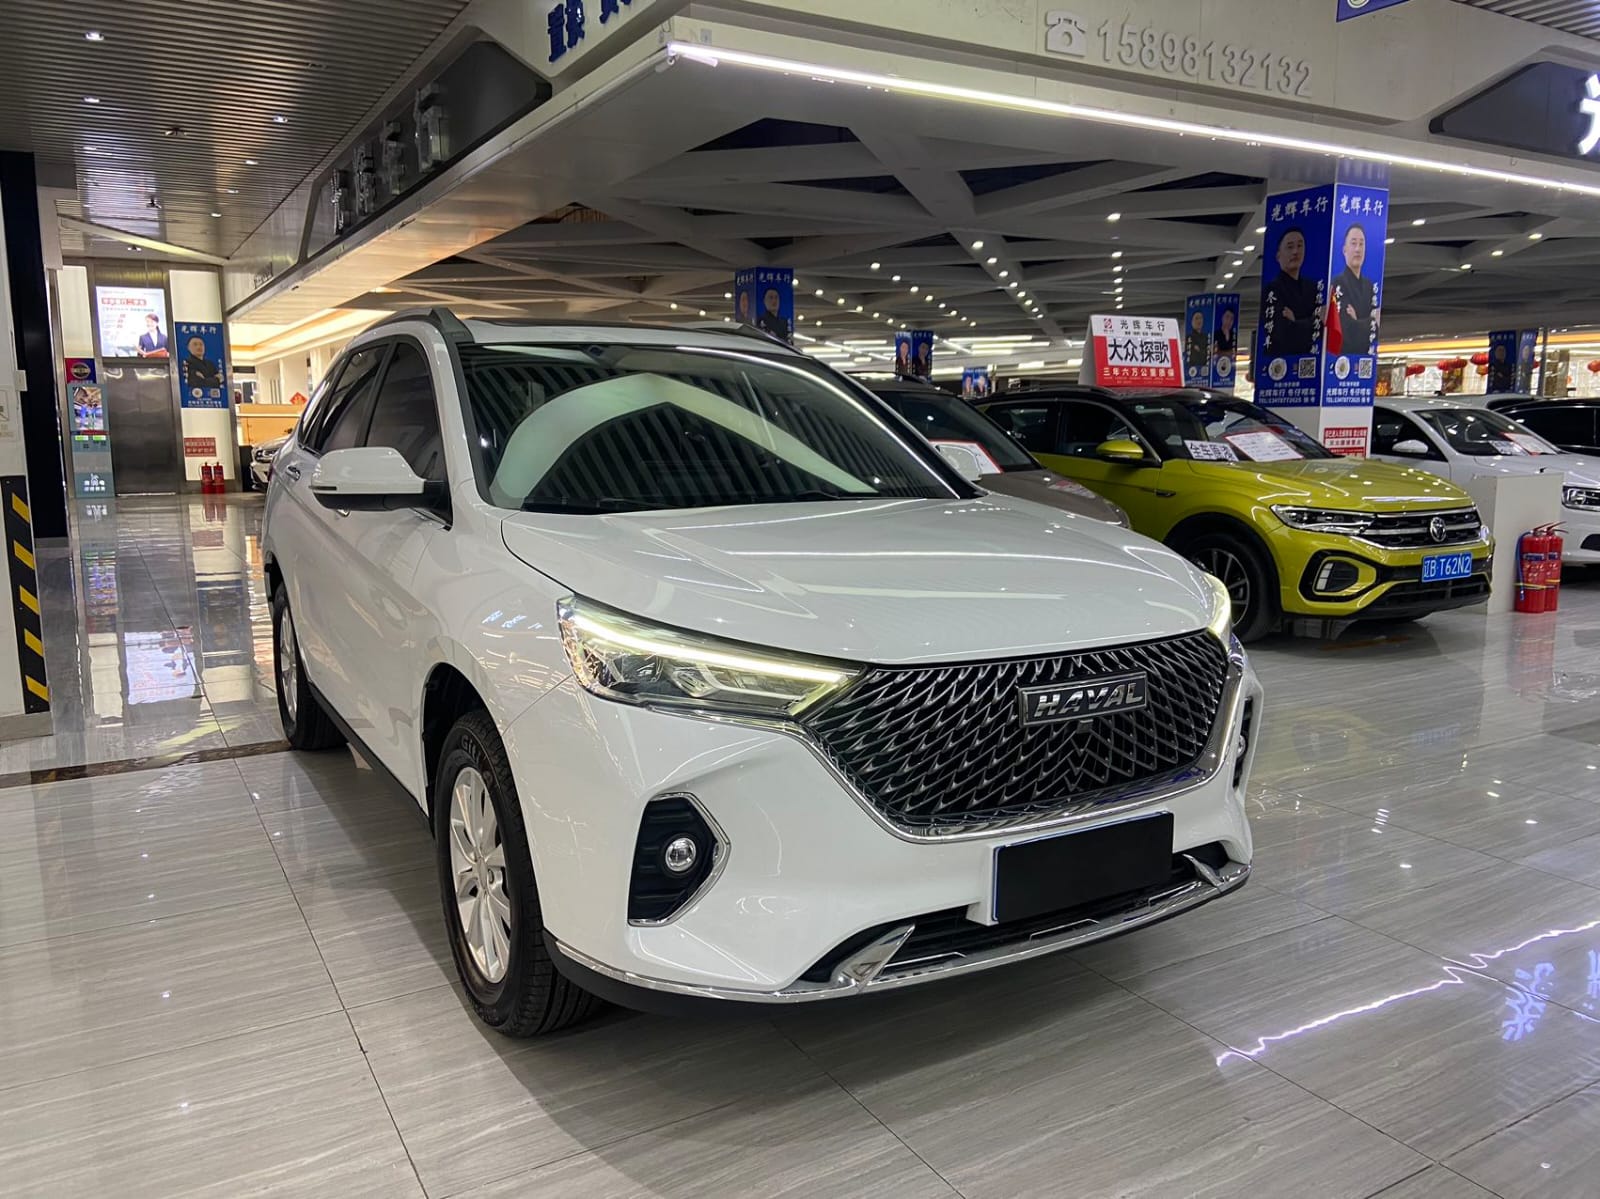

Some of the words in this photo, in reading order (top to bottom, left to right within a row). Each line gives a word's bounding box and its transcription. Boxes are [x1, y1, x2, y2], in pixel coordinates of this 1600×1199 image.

[1097, 18, 1313, 99] 15898132132
[1120, 319, 1165, 331] 光辉车行
[1108, 338, 1169, 364] 大众探歌
[1033, 682, 1144, 718] HAVAL
